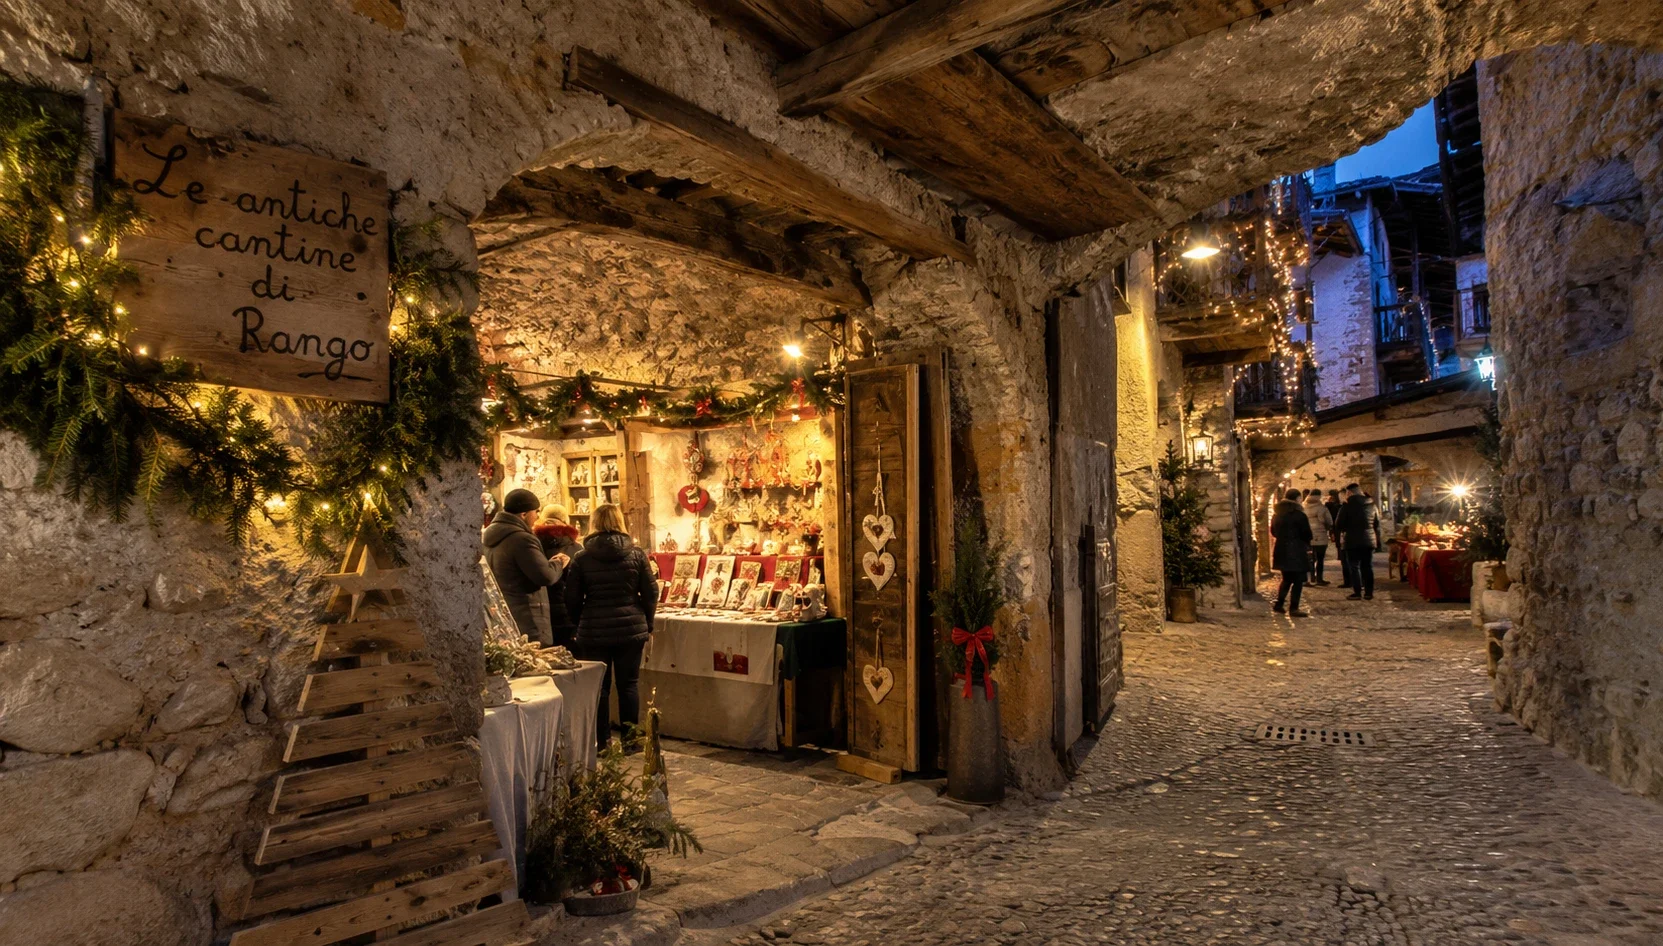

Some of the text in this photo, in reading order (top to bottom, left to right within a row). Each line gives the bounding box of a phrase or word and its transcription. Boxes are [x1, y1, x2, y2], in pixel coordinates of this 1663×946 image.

[132, 144, 379, 237] Le antiche
[195, 224, 357, 273] cantine
[251, 265, 296, 301] di
[232, 306, 375, 382] Rango
